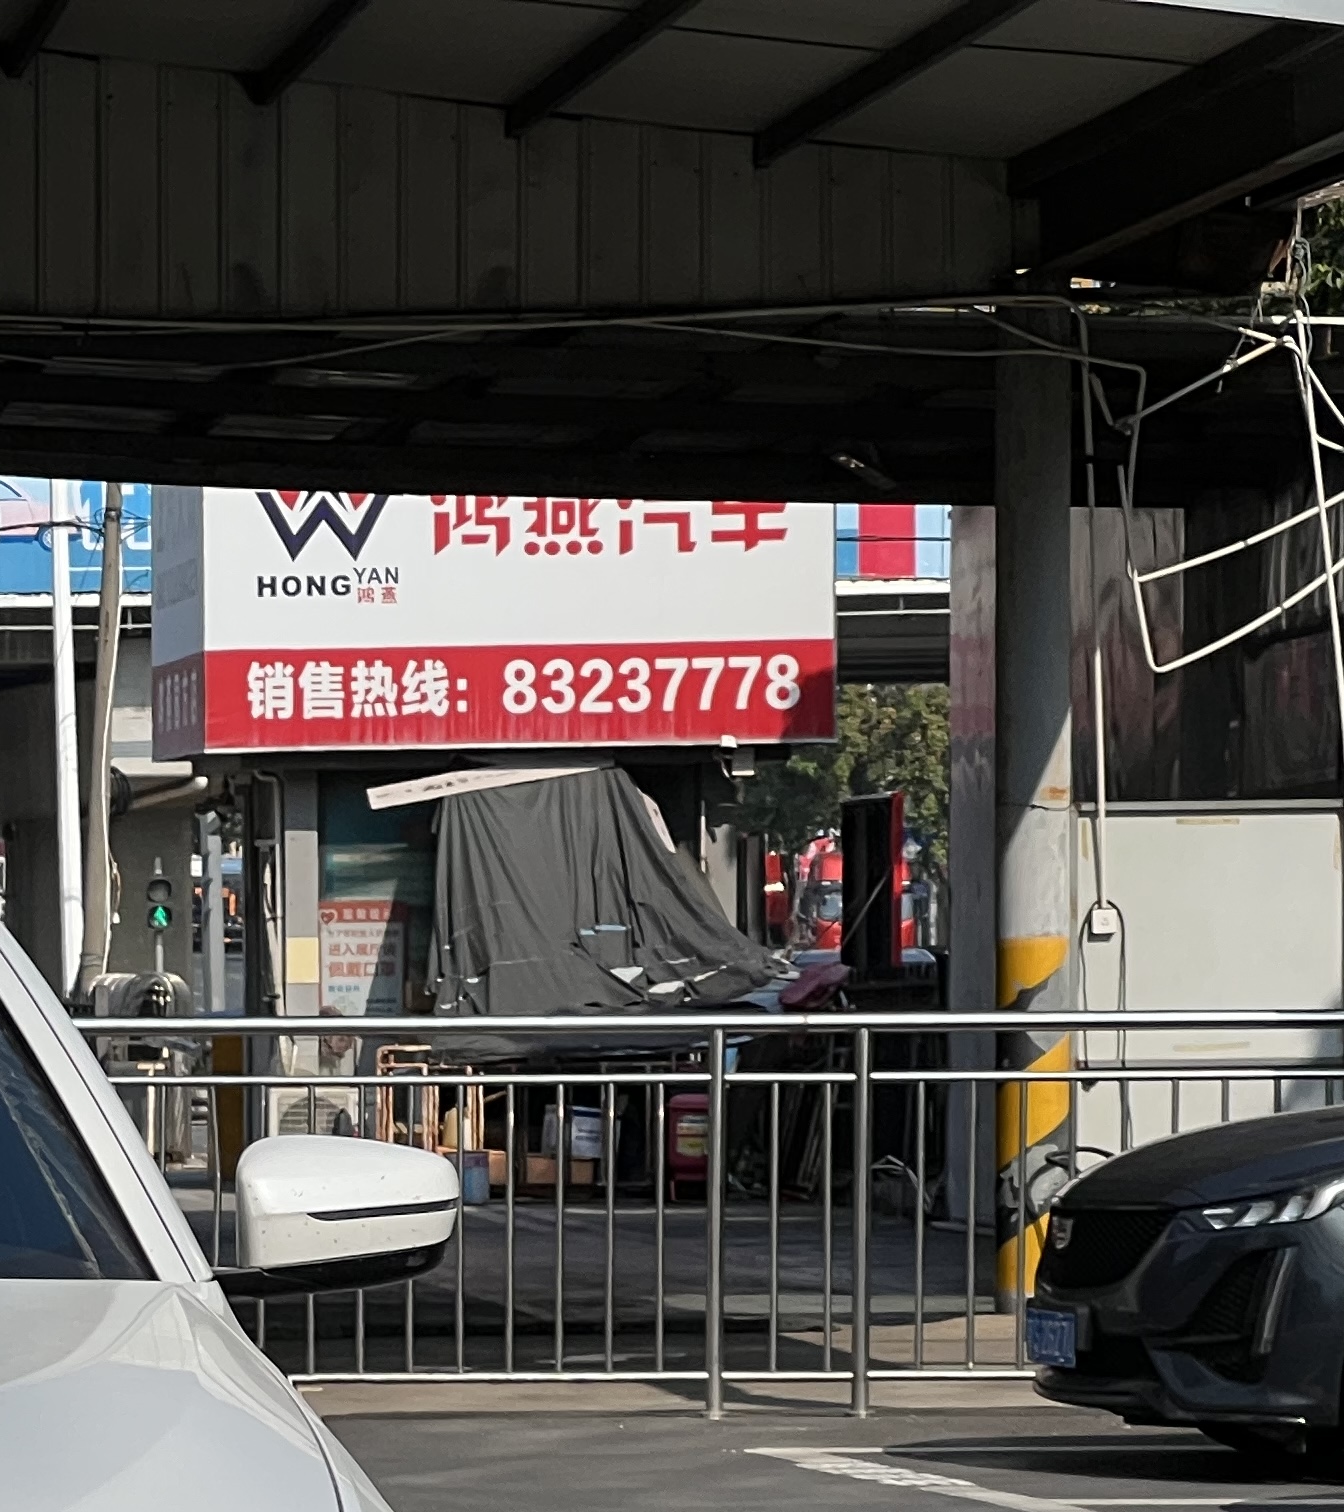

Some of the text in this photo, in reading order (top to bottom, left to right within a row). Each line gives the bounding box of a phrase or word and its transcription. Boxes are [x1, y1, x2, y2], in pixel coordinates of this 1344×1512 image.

[257, 566, 399, 598] HONG YAN
[357, 586, 398, 604] 鸿燕
[246, 659, 468, 720] 销售热线：
[502, 653, 801, 715] 83237778
